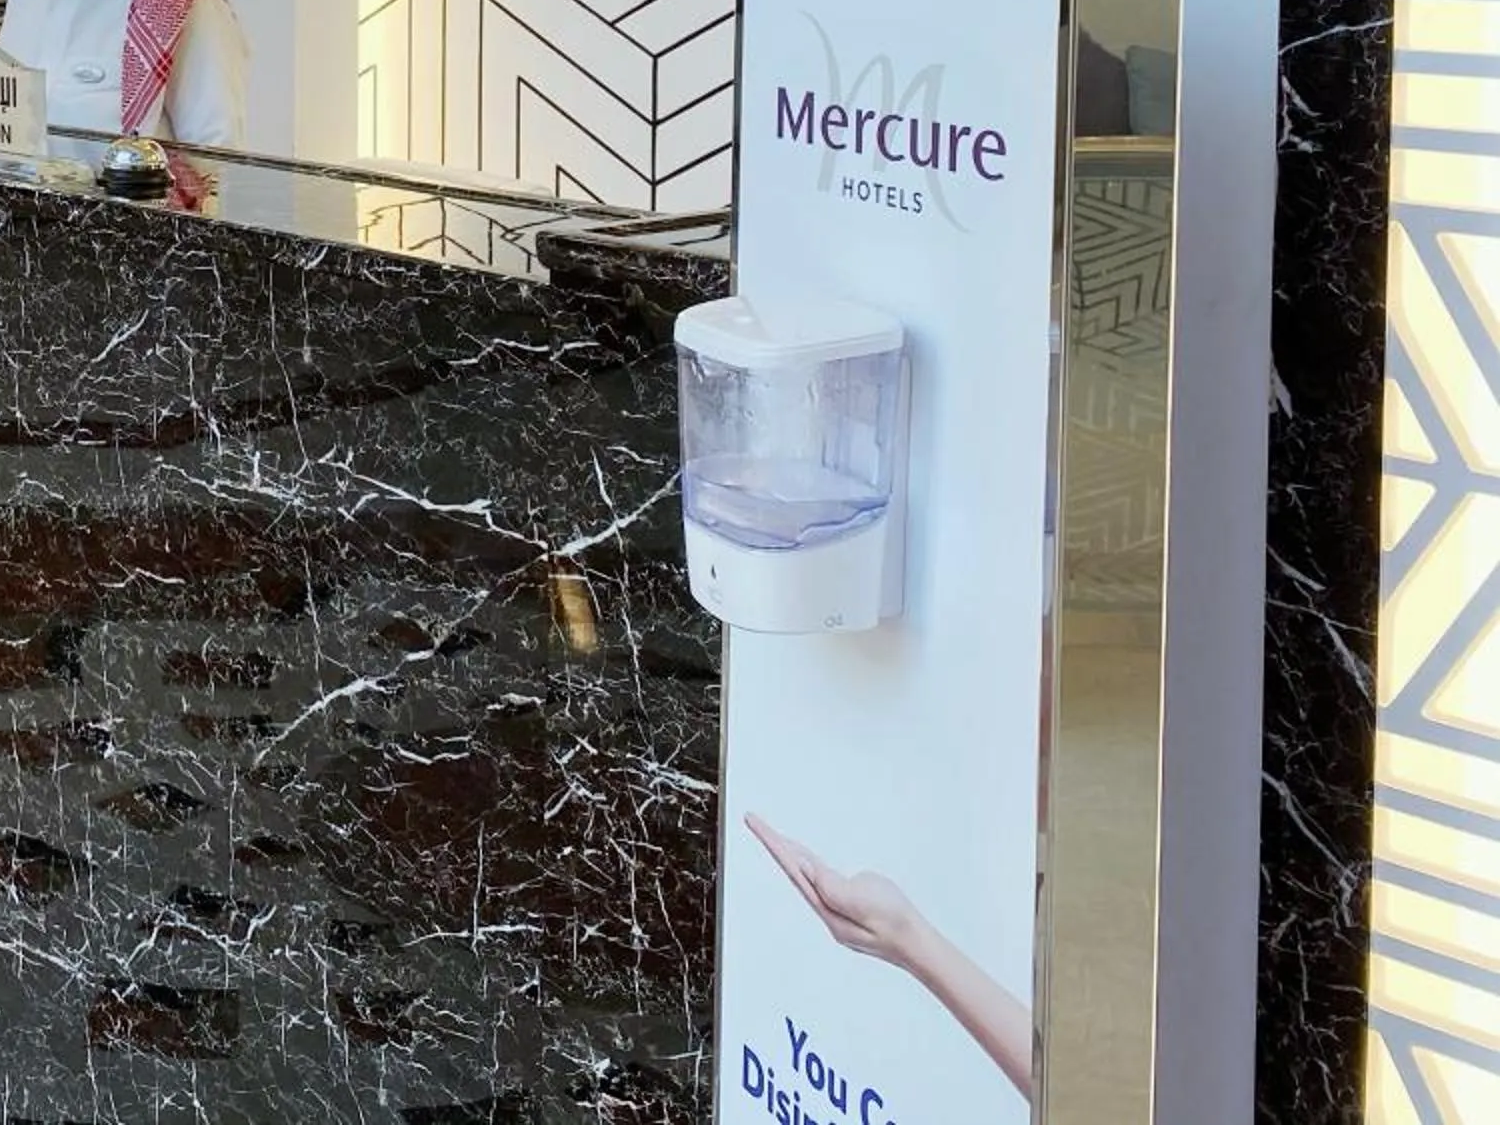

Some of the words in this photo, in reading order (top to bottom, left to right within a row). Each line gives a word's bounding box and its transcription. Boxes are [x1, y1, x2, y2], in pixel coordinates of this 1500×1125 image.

[776, 86, 1007, 181] Mercure
[842, 177, 924, 214] HOTELS
[785, 1015, 847, 1115] You
